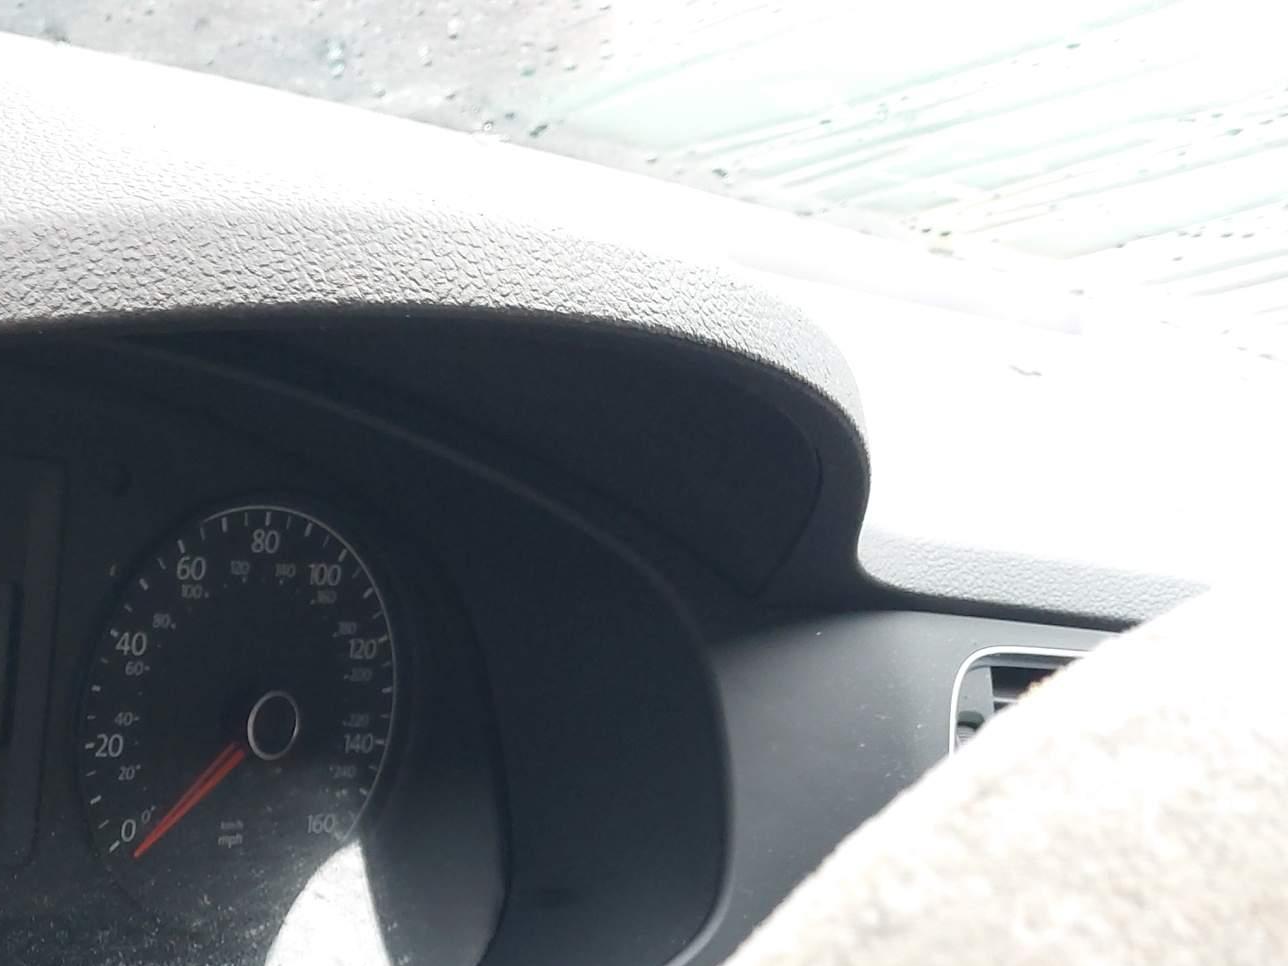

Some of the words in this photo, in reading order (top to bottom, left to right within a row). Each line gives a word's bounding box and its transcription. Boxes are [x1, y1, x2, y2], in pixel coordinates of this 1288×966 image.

[251, 528, 280, 554] 80
[176, 556, 206, 581] 60
[309, 563, 342, 586] 100
[115, 631, 147, 656] 40
[349, 638, 377, 660] 120
[125, 660, 145, 676] 60
[114, 711, 133, 727] 40
[95, 733, 124, 758] 20
[344, 733, 374, 754] 140
[118, 766, 136, 781] 20
[121, 819, 137, 842] 0
[307, 813, 336, 834] 160
